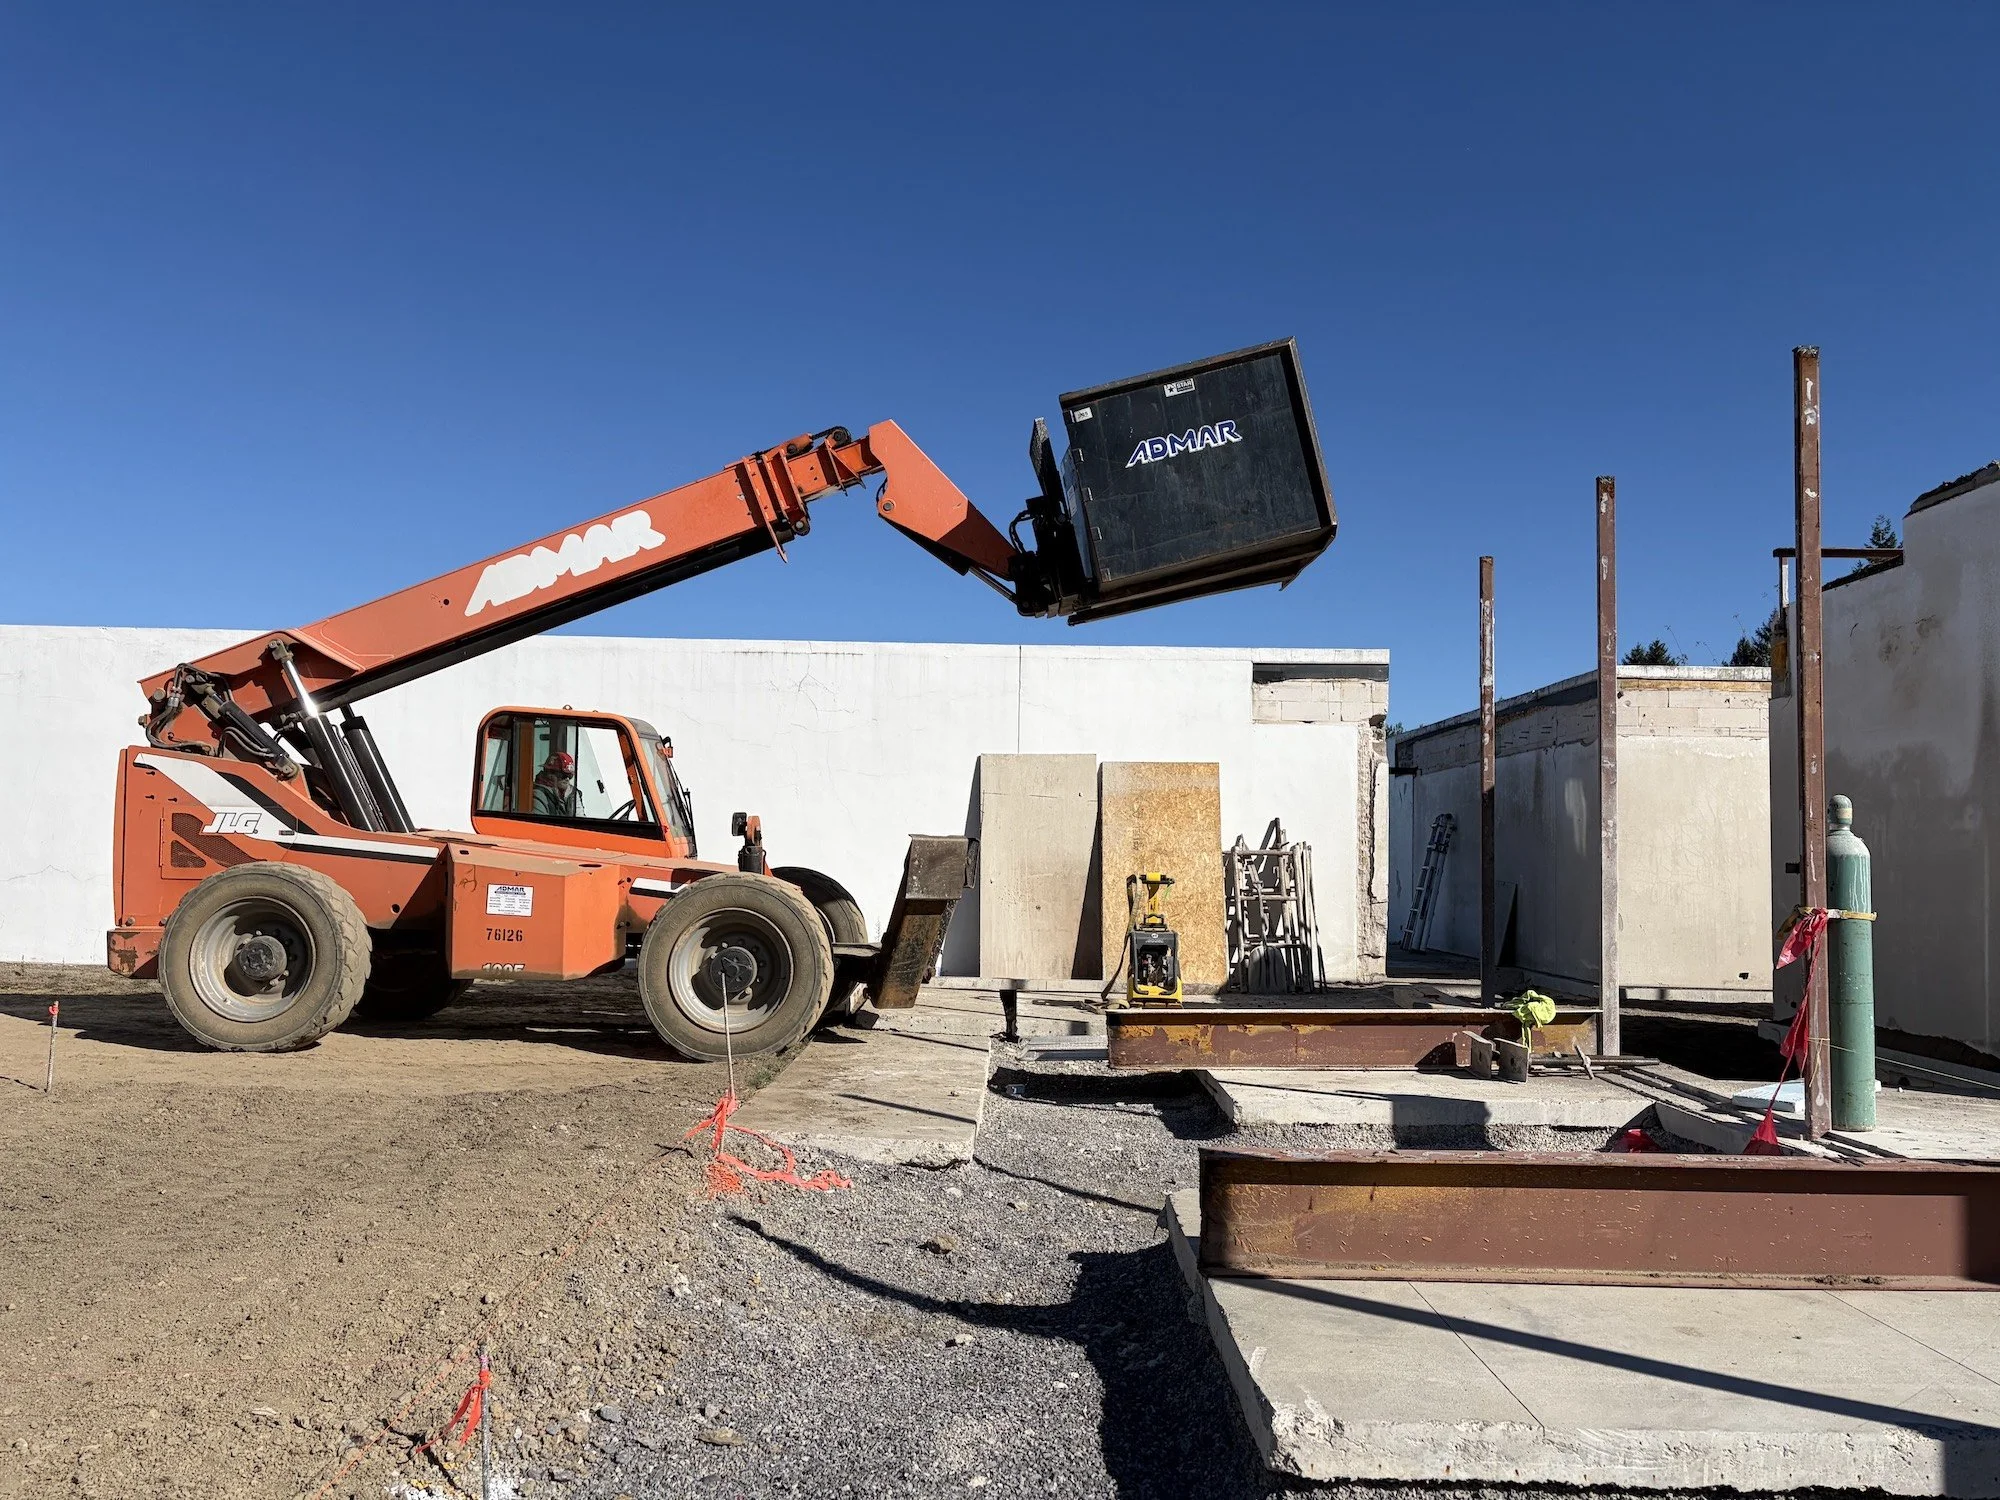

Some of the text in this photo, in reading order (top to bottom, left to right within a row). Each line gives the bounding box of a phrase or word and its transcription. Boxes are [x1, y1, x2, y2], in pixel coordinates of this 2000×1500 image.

[1125, 419, 1243, 469] ADMAR
[201, 812, 262, 834] JLG
[486, 928, 523, 942] 76126
